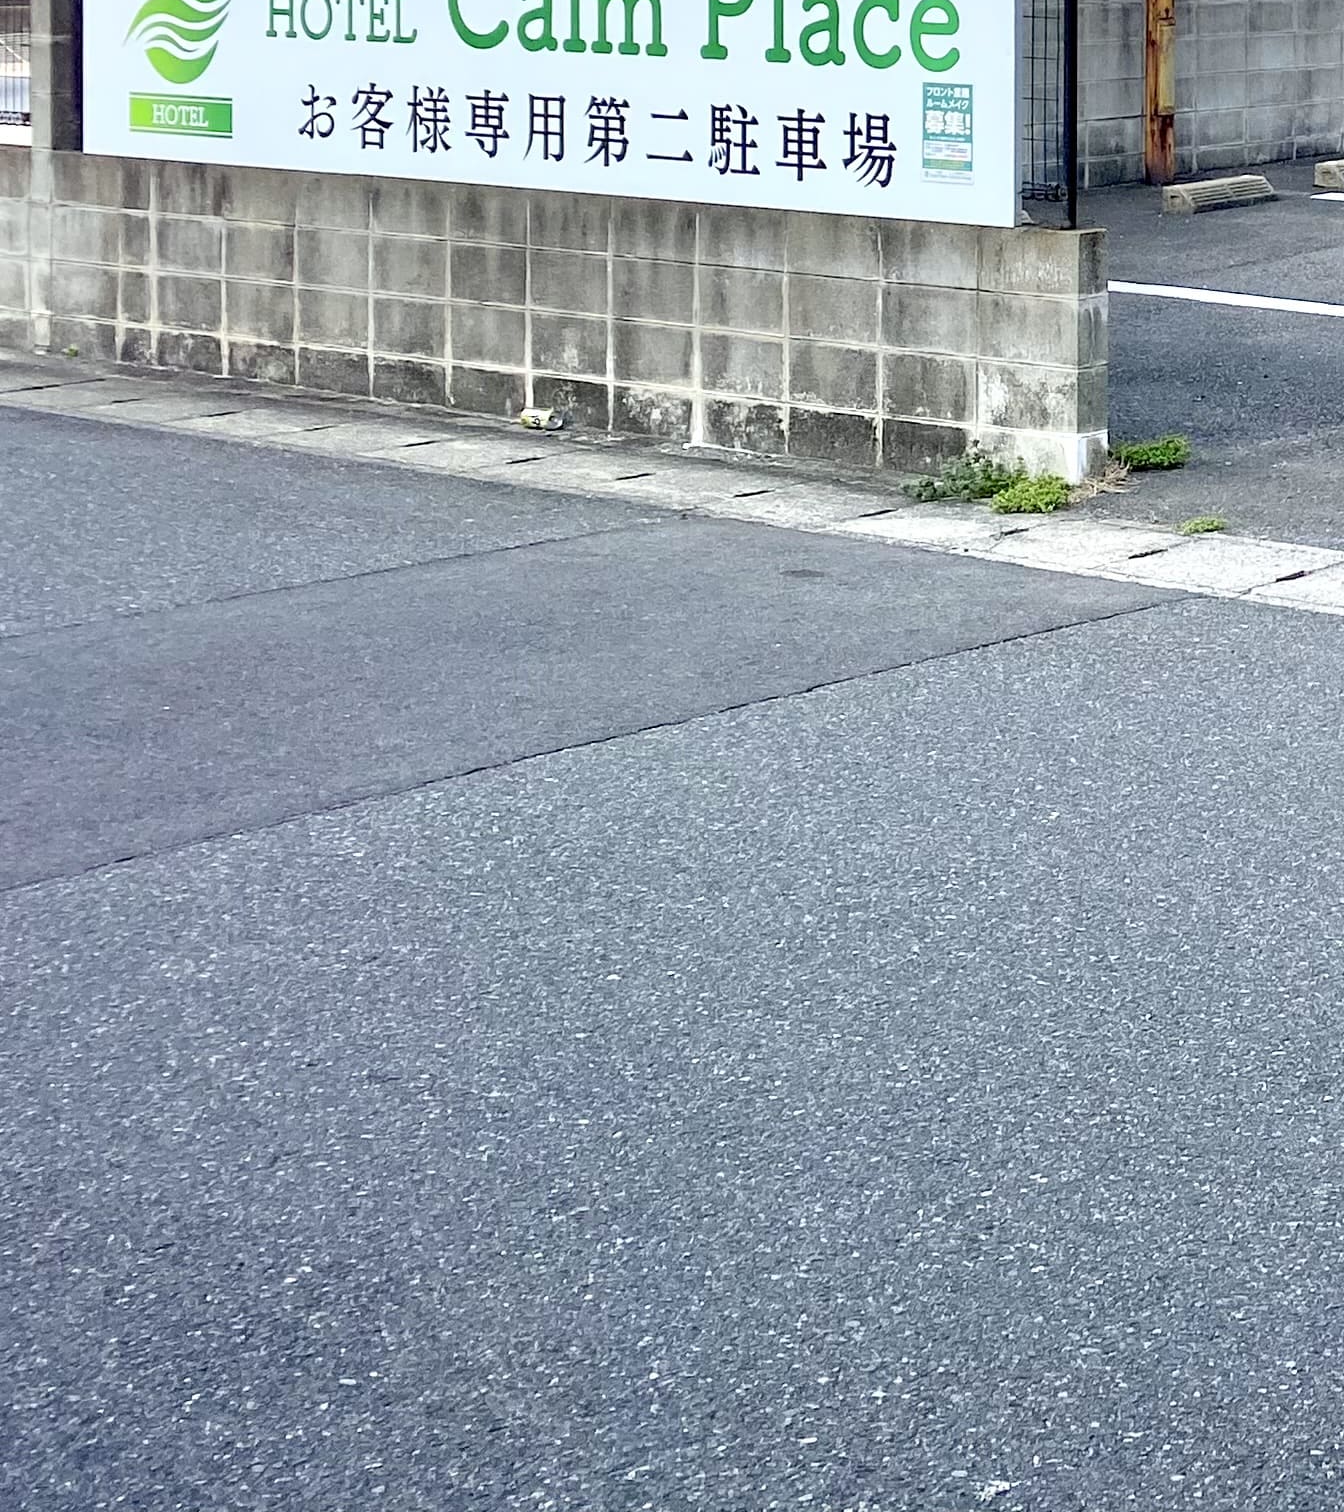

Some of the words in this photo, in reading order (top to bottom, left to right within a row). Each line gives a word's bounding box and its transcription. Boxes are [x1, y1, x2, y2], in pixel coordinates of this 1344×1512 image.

[151, 103, 209, 128] HOTEL
[298, 82, 898, 189] お客様専用第二駐車場
